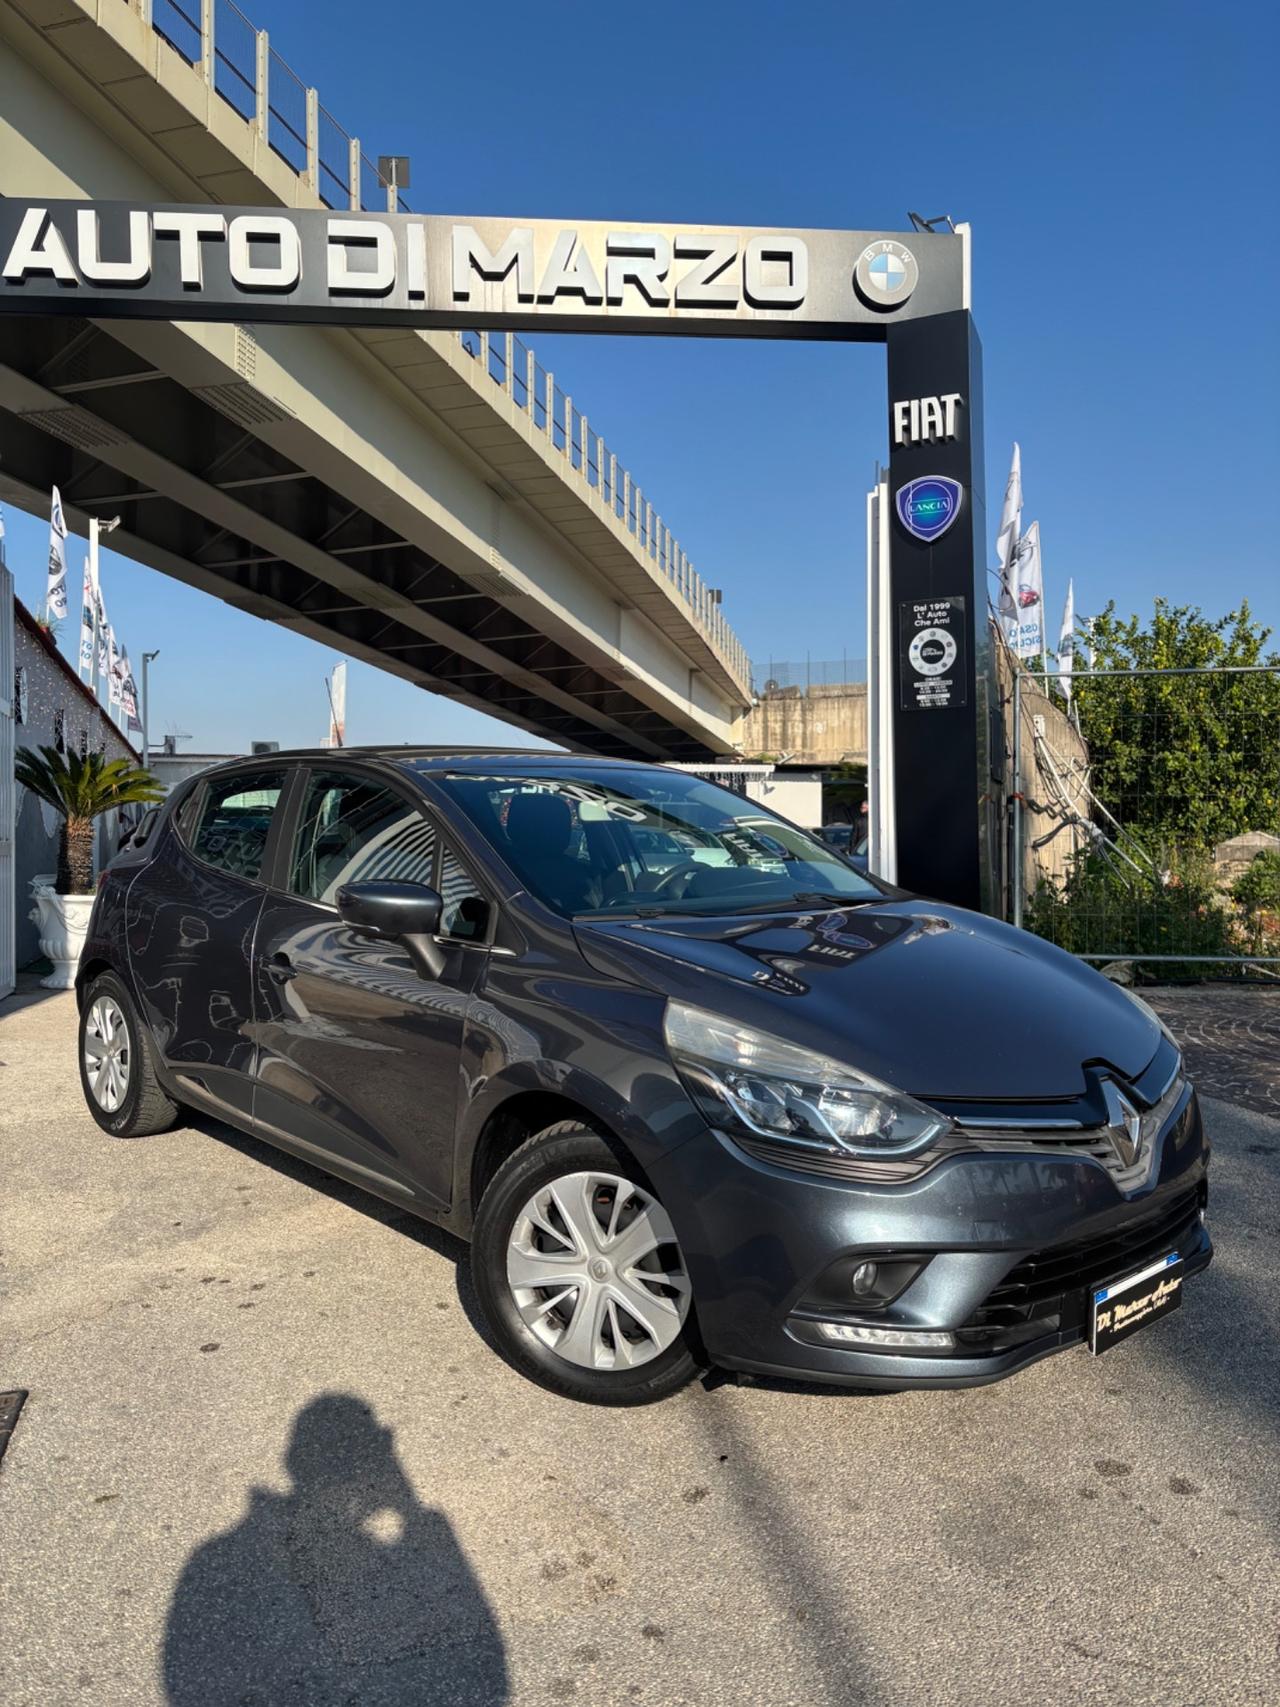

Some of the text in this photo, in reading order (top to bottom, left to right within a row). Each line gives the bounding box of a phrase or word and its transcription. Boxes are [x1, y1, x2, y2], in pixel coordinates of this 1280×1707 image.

[2, 207, 809, 311] AUTO DI MARZO
[864, 243, 913, 262] BMW
[893, 393, 962, 445] FIAT
[911, 501, 948, 512] LANCIA
[913, 602, 950, 612] Dal 1999
[914, 616, 950, 627] Che Ami
